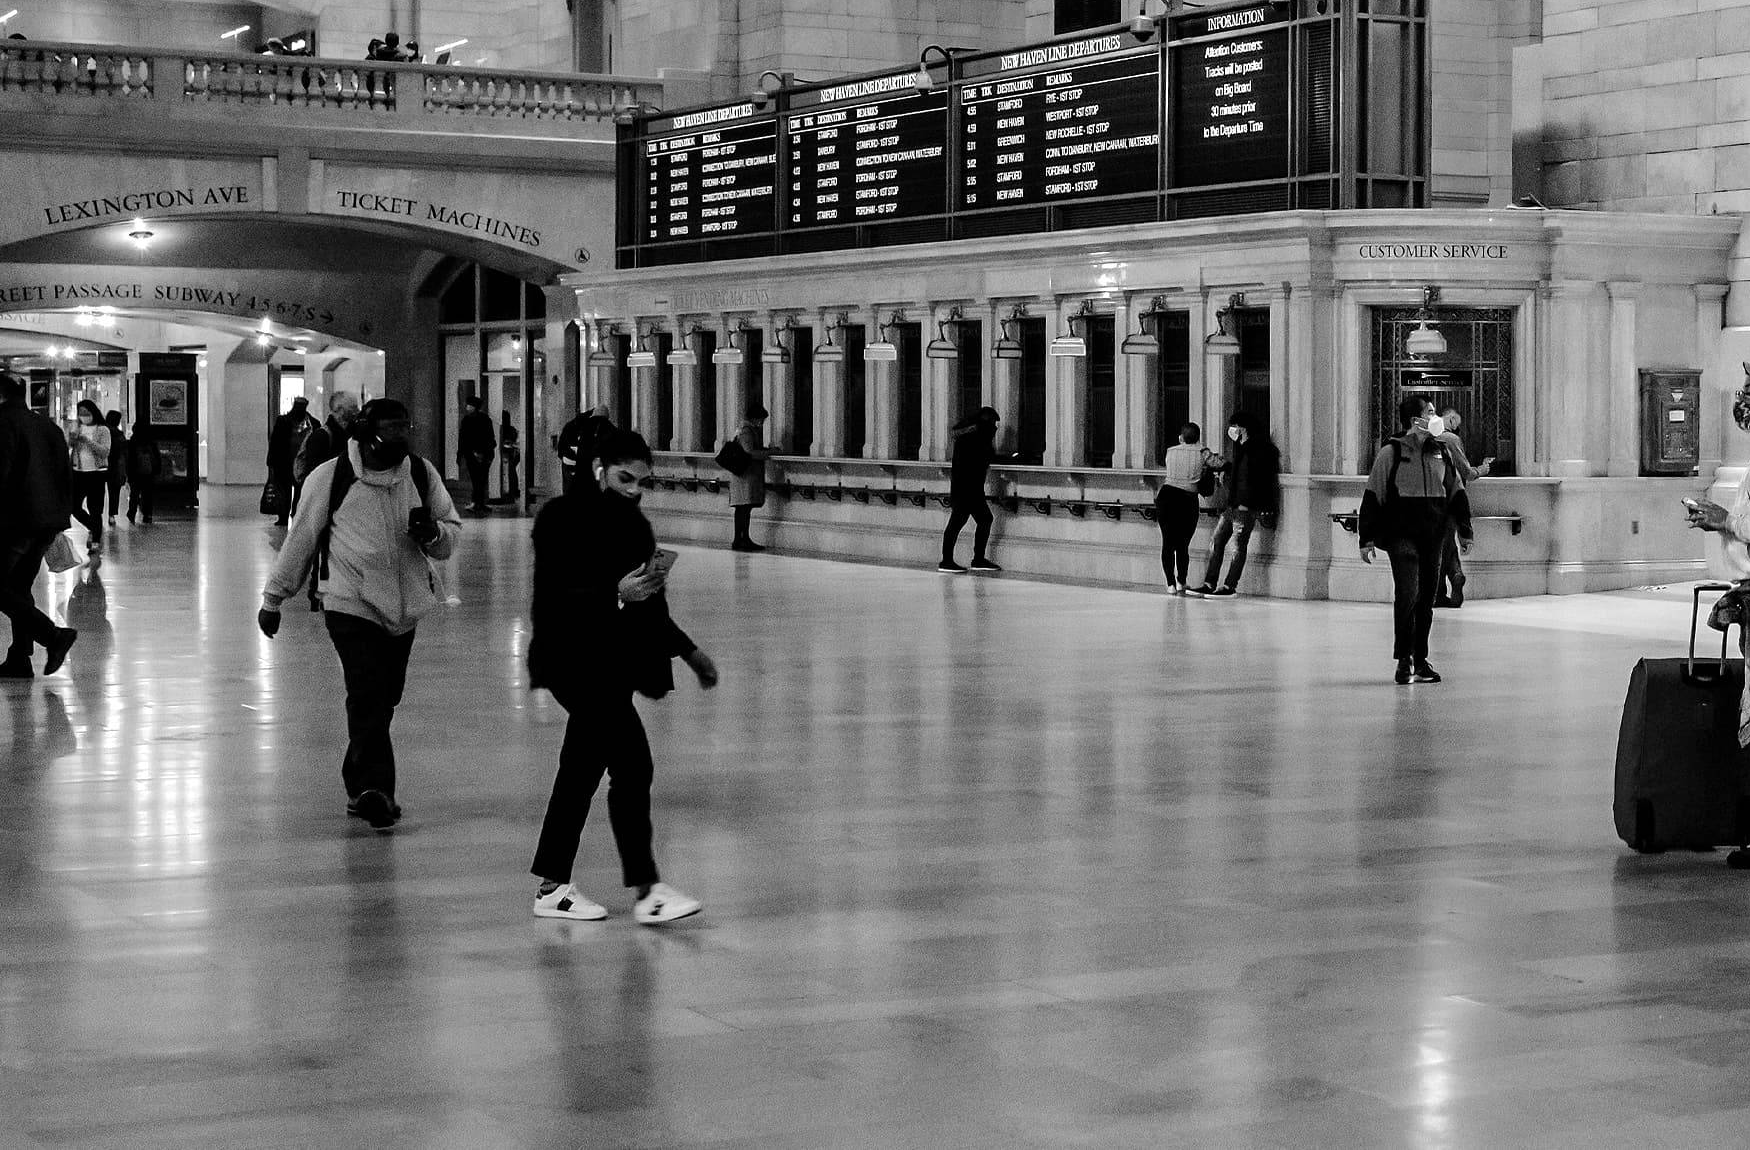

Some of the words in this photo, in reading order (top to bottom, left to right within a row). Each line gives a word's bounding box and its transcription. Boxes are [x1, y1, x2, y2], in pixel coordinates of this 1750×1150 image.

[1207, 8, 1265, 31] INFORMATION
[1000, 53, 1020, 70] NEW
[1019, 48, 1048, 67] HAVEN
[1047, 45, 1068, 62] LINE
[1067, 34, 1121, 59] DEPARTURES
[1204, 44, 1230, 59] Attention
[1204, 65, 1225, 78] Tracks
[1225, 62, 1234, 75] will
[1234, 62, 1243, 74] be
[1242, 58, 1263, 75] posted
[820, 87, 835, 103] NEW
[835, 83, 859, 100] HAVEN
[859, 80, 875, 96] LINE
[874, 72, 917, 94] DEPARTURES
[1215, 86, 1224, 97] on
[1223, 83, 1234, 97] Big
[1233, 80, 1252, 94] Board
[1210, 105, 1219, 117] 30
[1219, 102, 1242, 116] minutes
[1241, 100, 1256, 115] prior
[1203, 126, 1210, 138] to
[1210, 125, 1220, 137] the
[1219, 122, 1248, 137] Departure
[1247, 119, 1264, 132] Time
[44, 188, 194, 225] LEXINGTON
[203, 186, 249, 204] AVE
[336, 190, 418, 216] TICKET
[426, 203, 542, 247] MACHINES
[1359, 244, 1438, 259] CUSTOMER
[1443, 244, 1509, 259] SERVICE
[54, 283, 143, 299] PASSAGE
[154, 285, 241, 307] SUBWAY
